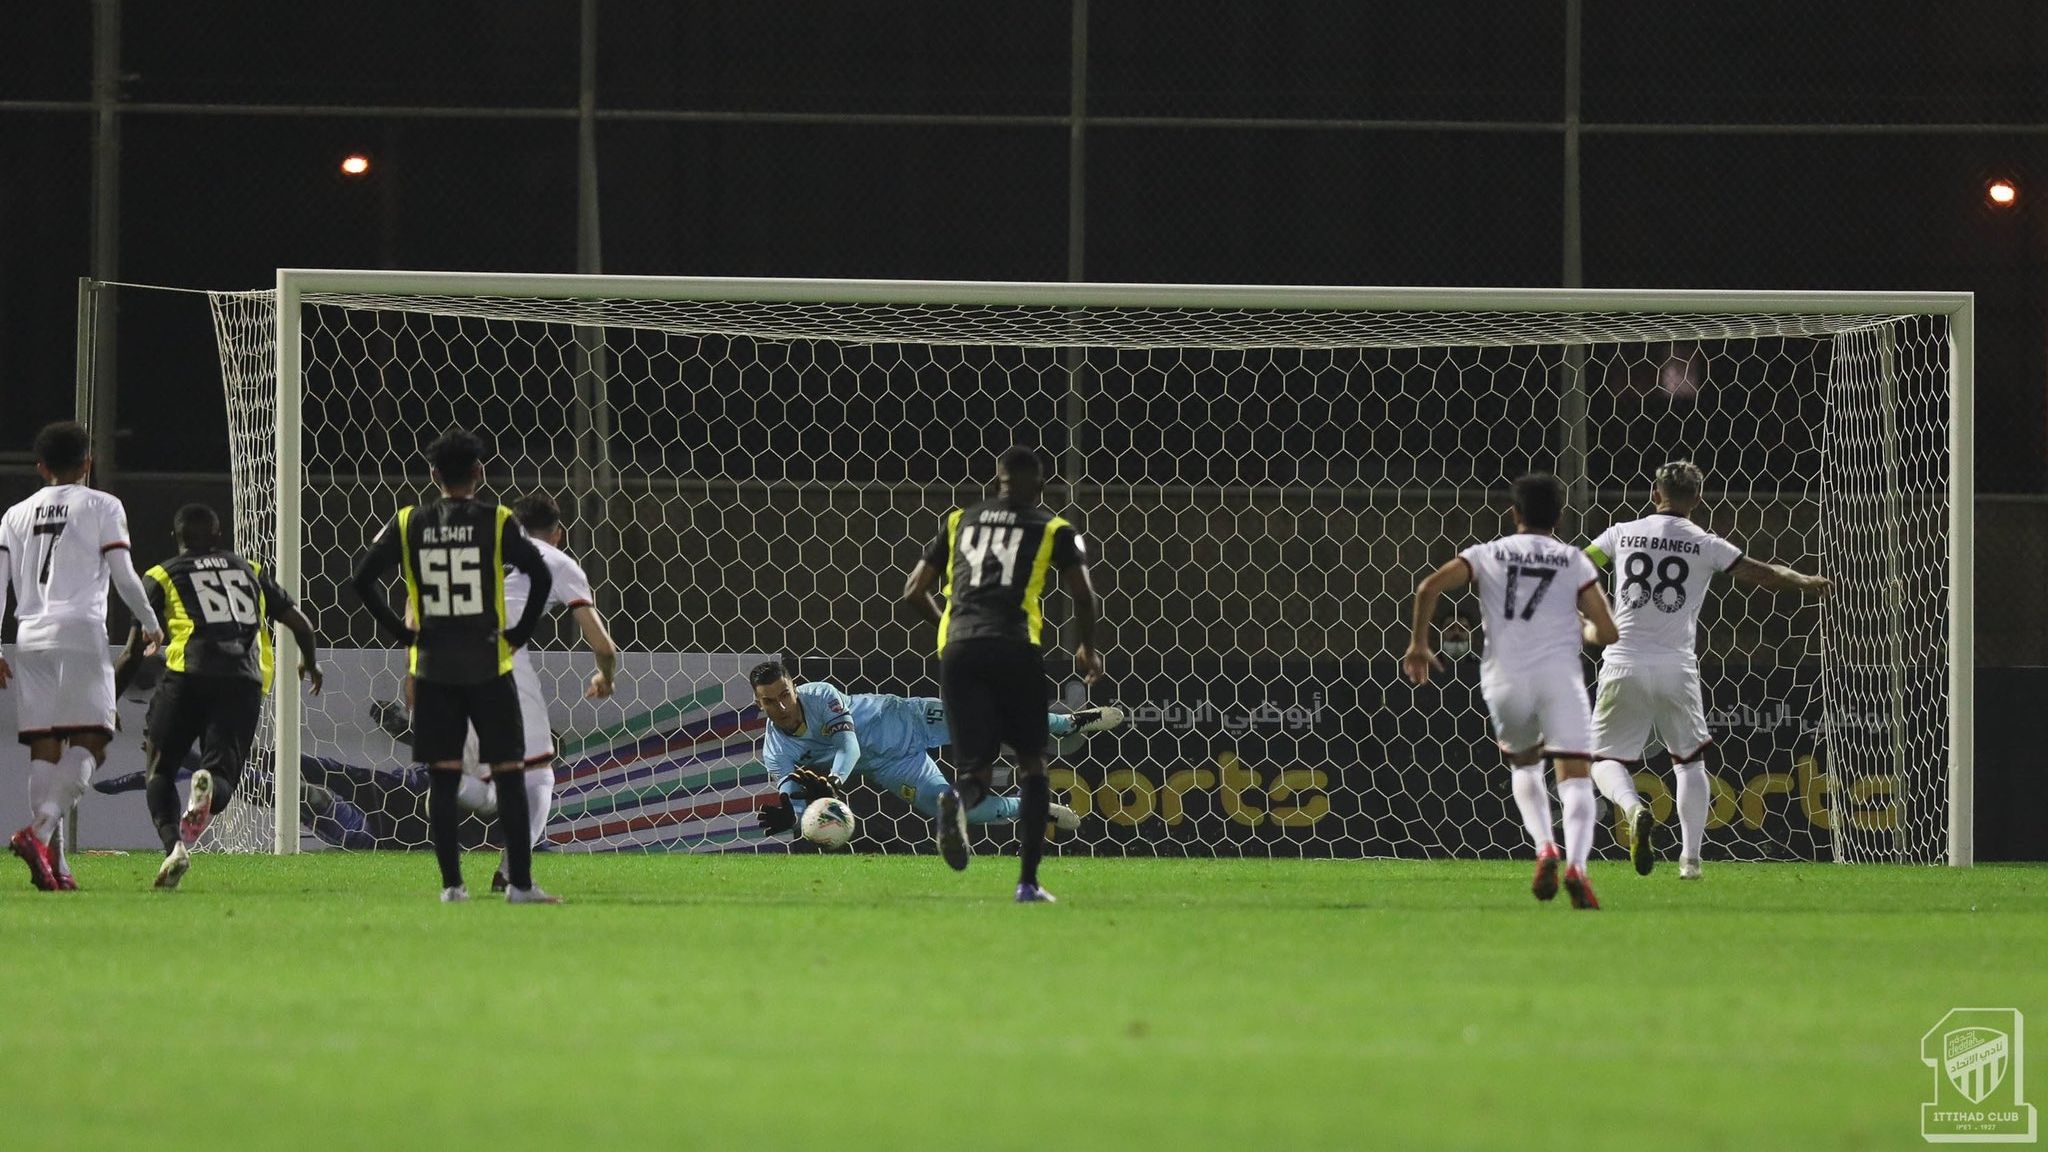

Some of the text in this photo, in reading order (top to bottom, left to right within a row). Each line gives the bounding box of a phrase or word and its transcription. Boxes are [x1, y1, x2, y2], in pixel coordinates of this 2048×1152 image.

[35, 504, 69, 519] TURKI
[979, 510, 1017, 525] OMAR
[33, 521, 67, 585] 7
[194, 557, 228, 570] SAUD
[960, 525, 1024, 588] 44
[1620, 536, 1700, 556] EVER BANEGA
[189, 569, 257, 625] 66
[418, 547, 484, 617] 55
[1504, 565, 1557, 621] 17
[1620, 552, 1690, 614] 88
[1000, 751, 1329, 842] ports
